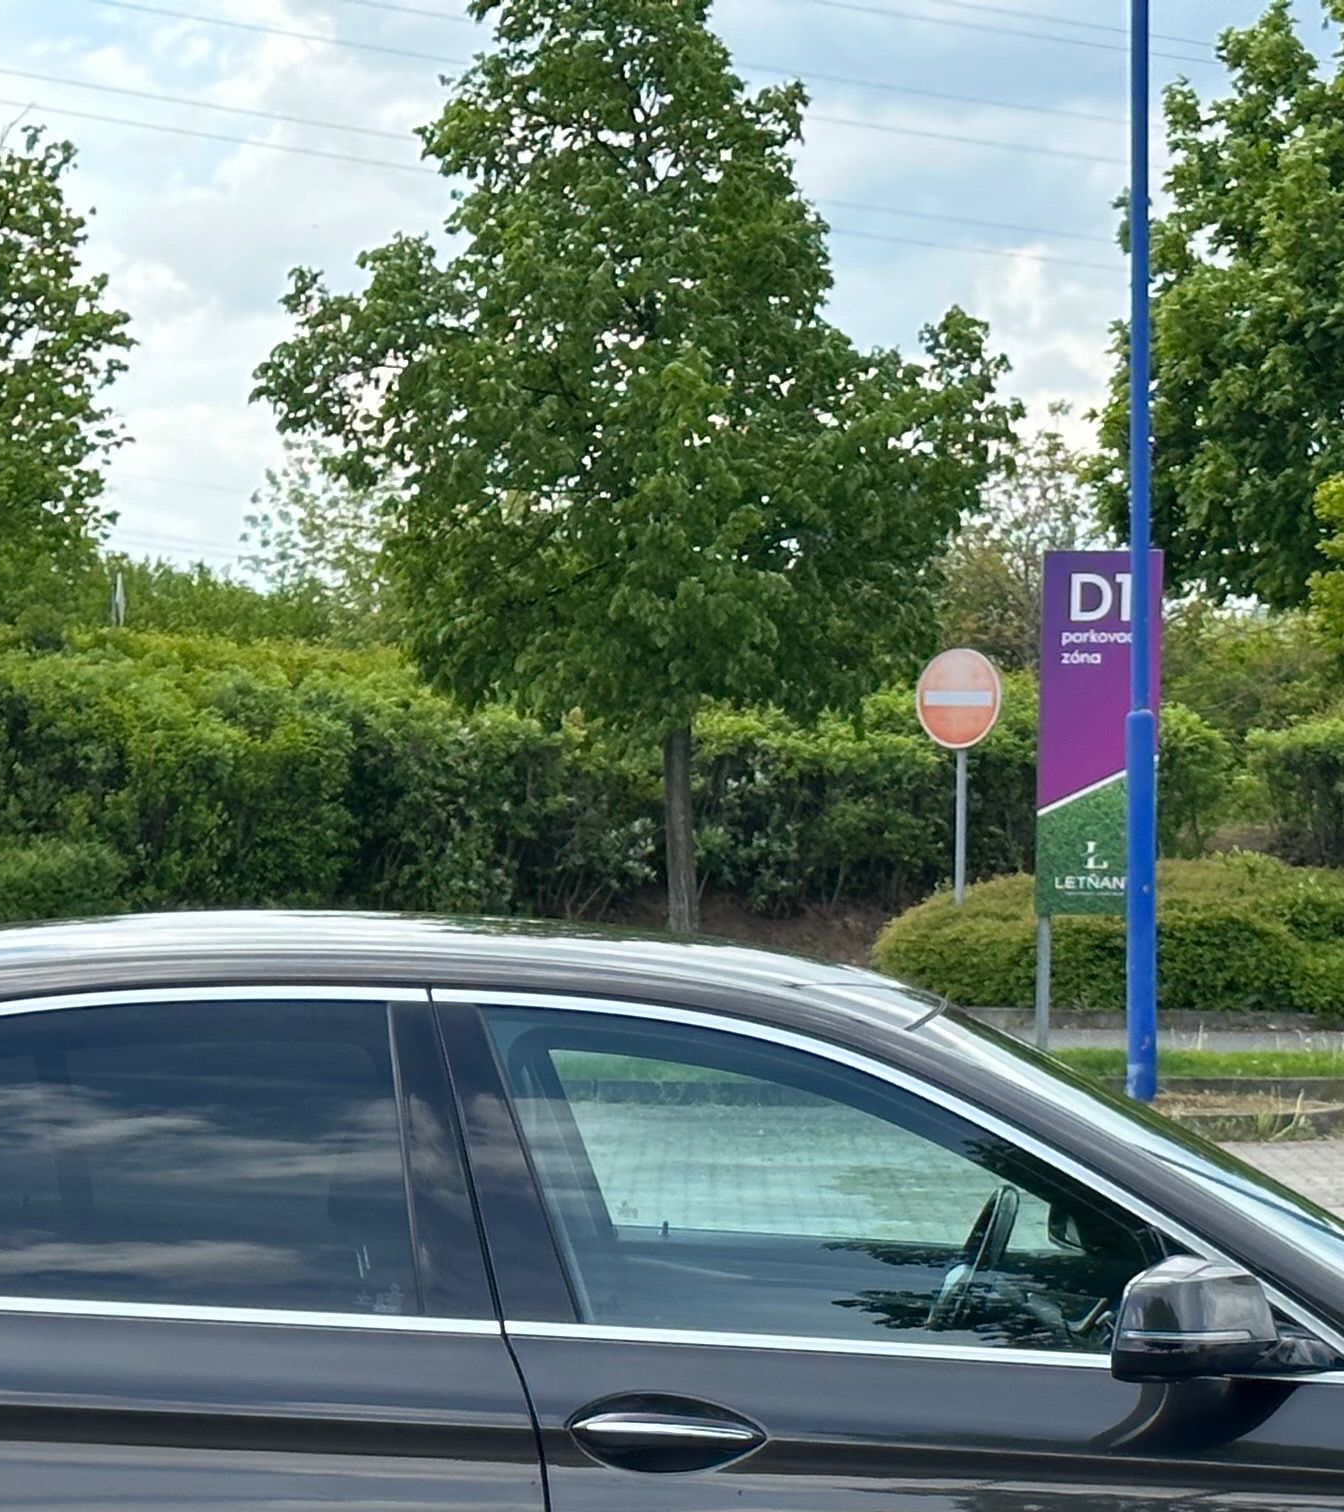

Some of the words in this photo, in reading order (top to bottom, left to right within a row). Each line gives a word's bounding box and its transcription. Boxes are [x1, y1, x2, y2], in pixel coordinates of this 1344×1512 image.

[1069, 573, 1133, 621] D1
[1060, 649, 1101, 664] zóna
[1054, 873, 1129, 890] LETŇAN
